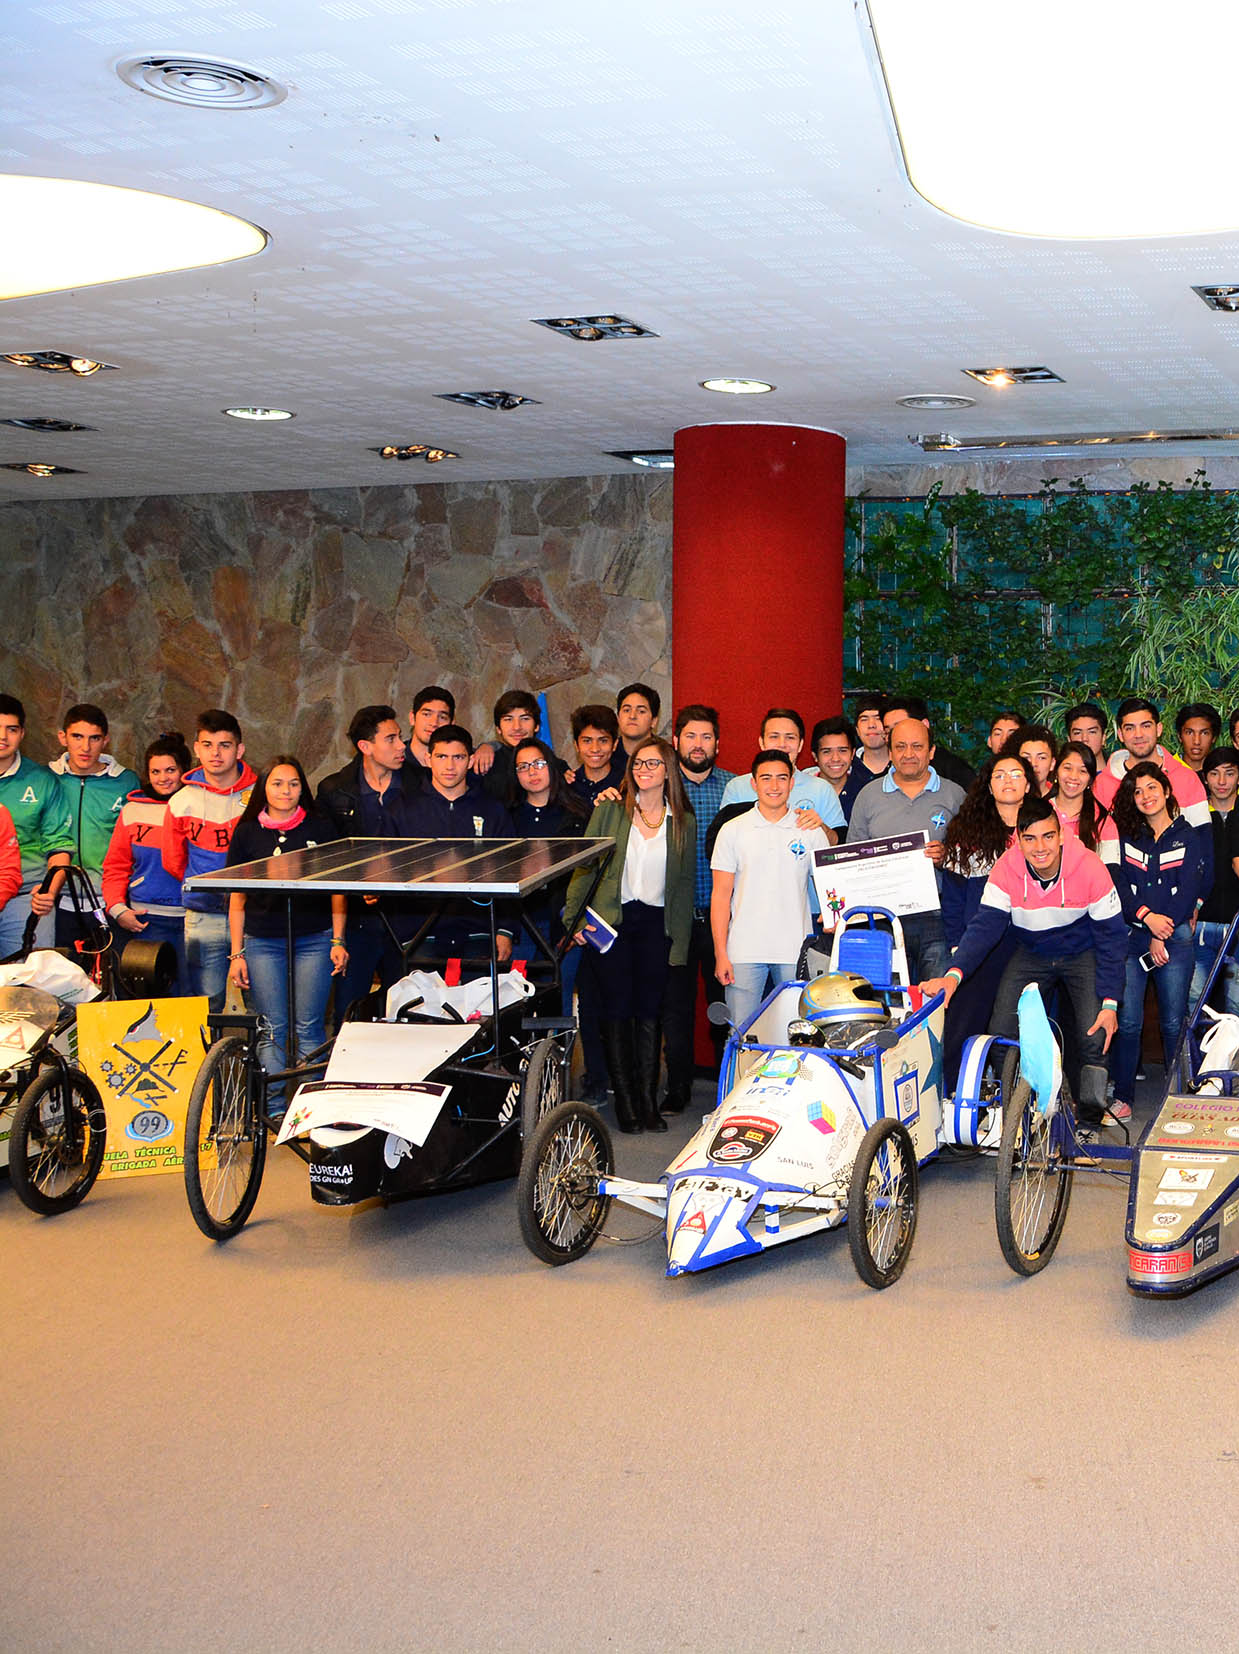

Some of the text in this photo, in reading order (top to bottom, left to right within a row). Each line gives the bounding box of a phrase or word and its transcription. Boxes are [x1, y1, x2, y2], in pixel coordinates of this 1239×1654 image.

[20, 786, 38, 802] A
[190, 822, 230, 847] V B
[1175, 1102, 1233, 1113] COLEGIO
[140, 1116, 160, 1133] 99
[104, 1152, 128, 1160] UELA
[135, 1146, 176, 1157] TÉCNICA
[111, 1160, 156, 1171] BRIGADA
[163, 1156, 184, 1167] AÉR
[309, 1164, 353, 1176] EUREKA!
